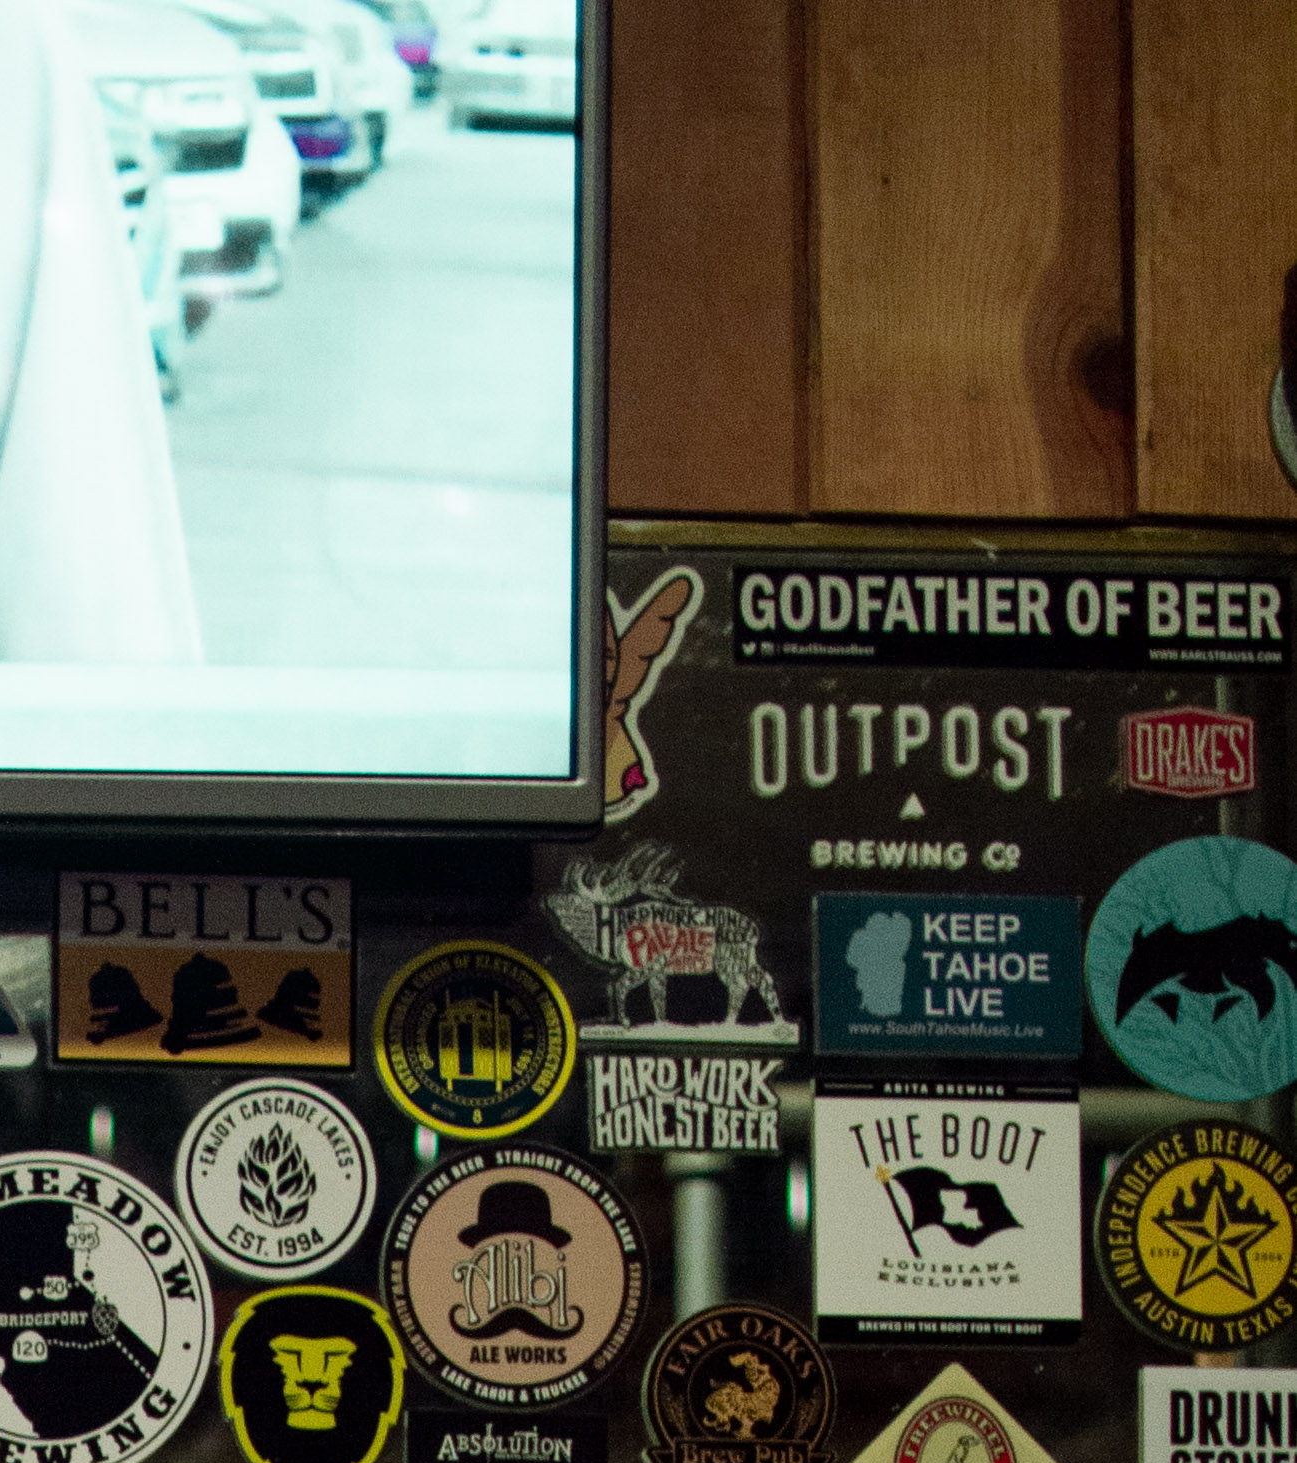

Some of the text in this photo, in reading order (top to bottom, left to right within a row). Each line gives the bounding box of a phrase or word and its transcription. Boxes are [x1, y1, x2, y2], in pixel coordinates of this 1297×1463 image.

[739, 572, 1283, 640] GODFATHER OF BEER
[749, 703, 1072, 800] OUTPOST
[811, 840, 968, 870] BREWING
[79, 879, 335, 945] BELL'S
[922, 913, 1021, 943] KEEP
[923, 952, 1050, 983] TAHOE
[923, 988, 1004, 1018] LIVE
[592, 1056, 783, 1113] HARD WORK
[596, 1095, 780, 1150] HONEST BEER
[849, 1113, 1047, 1172] THE BOOT
